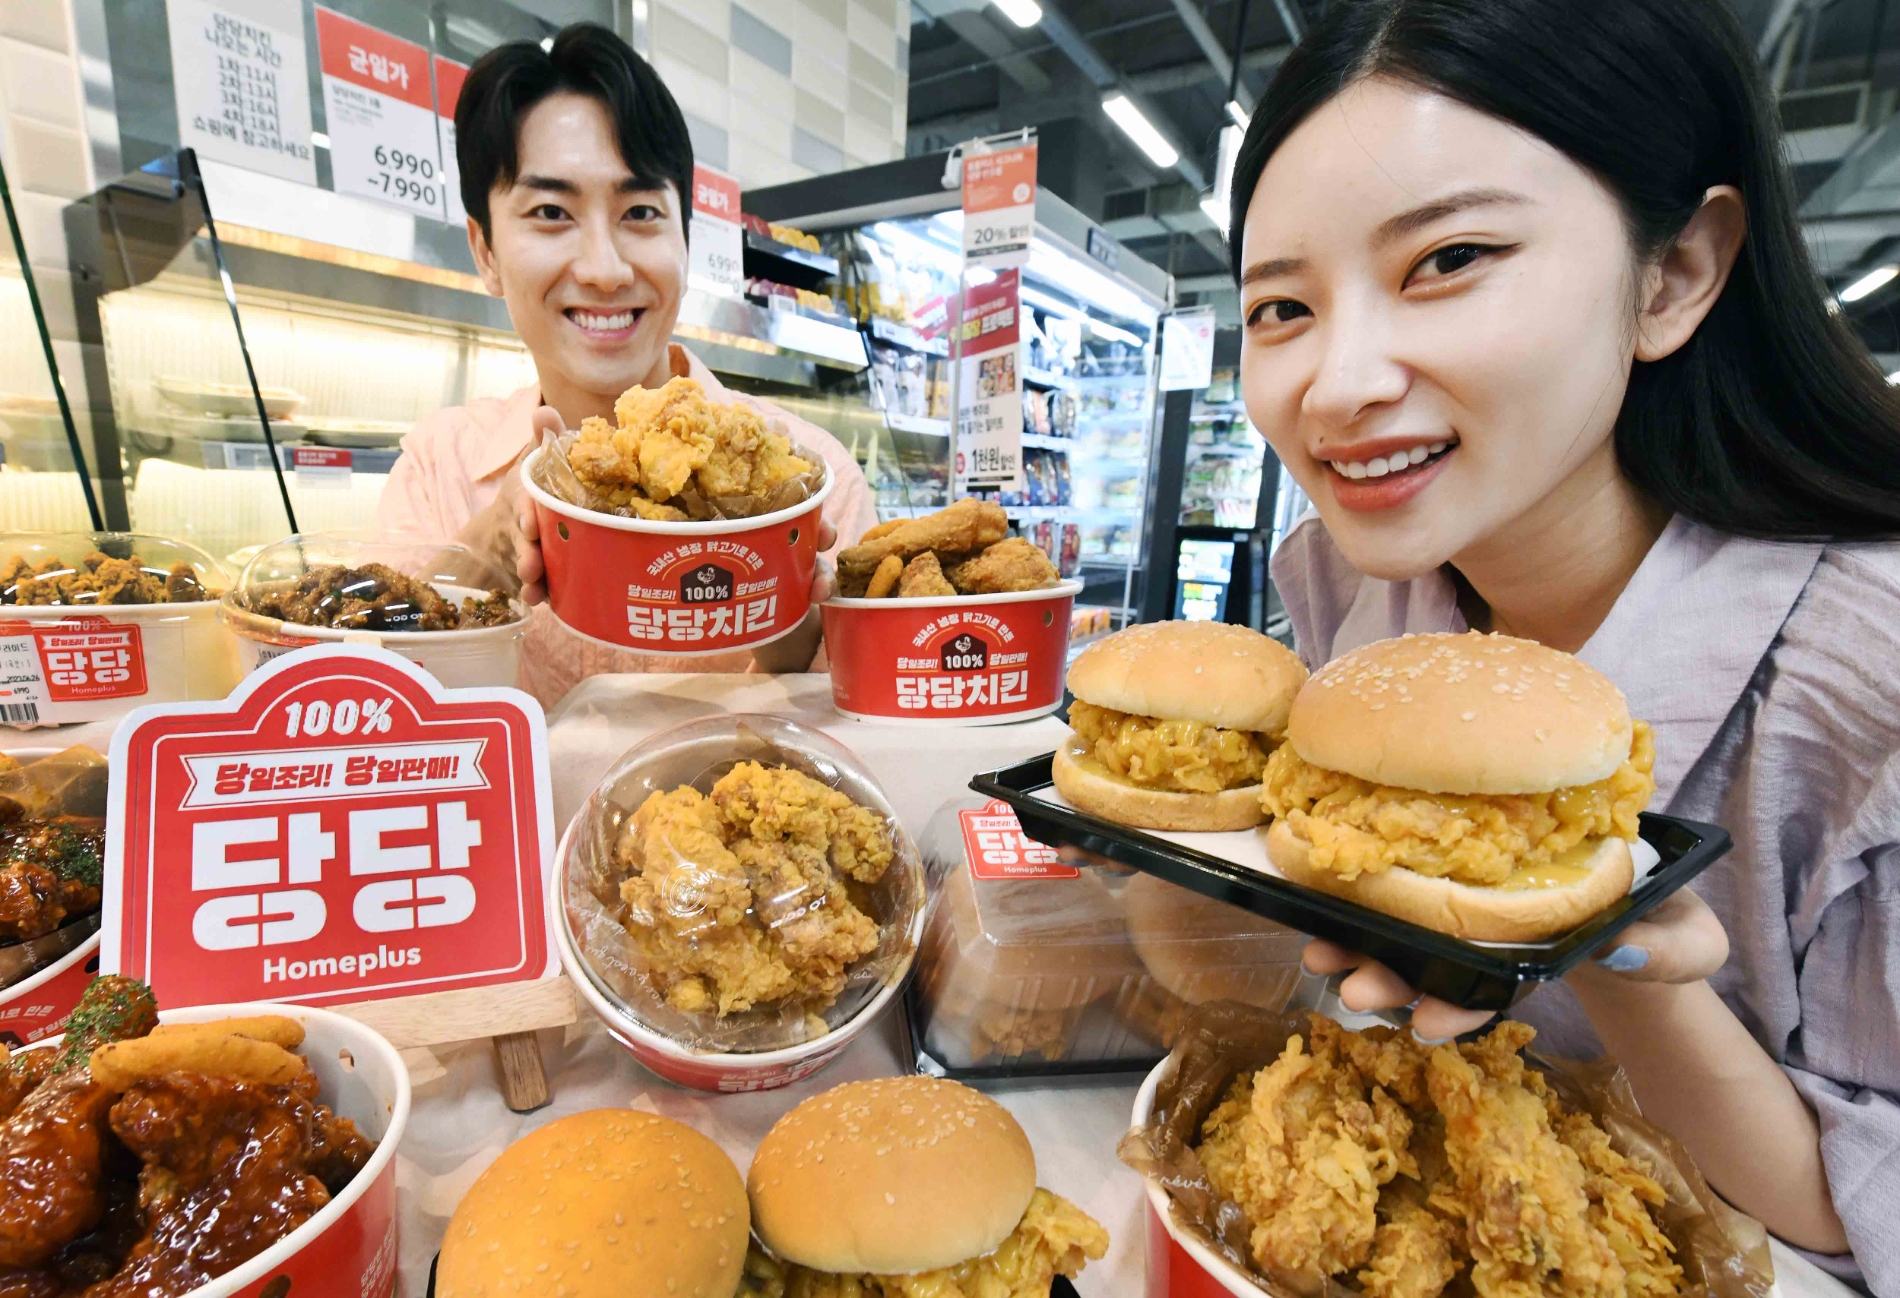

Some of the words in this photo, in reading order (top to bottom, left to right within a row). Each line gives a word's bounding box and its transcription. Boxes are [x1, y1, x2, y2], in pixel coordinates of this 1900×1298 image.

[255, 48, 281, 69] 시간
[348, 45, 409, 90] 균일가
[646, 551, 676, 576] 국내산
[676, 542, 702, 557] 냉장
[706, 541, 748, 556] 닭고기로
[746, 552, 765, 571] 만든
[628, 584, 676, 600] 당일조리!
[685, 585, 729, 601] 100%
[735, 576, 778, 596] 당일판매!
[626, 595, 778, 641] 당당치킨
[912, 622, 938, 647] 국내산
[936, 613, 959, 628] 냉장
[963, 612, 1000, 629] 닭고기로
[998, 624, 1015, 643] 만든
[0, 642, 29, 652] 라이드
[896, 657, 939, 669] 당일조리!
[945, 654, 983, 669] 100%
[989, 652, 1028, 666] 당일판매!
[47, 649, 131, 685] 당당
[71, 685, 116, 694] Homeplus
[896, 670, 1029, 709] 당당치킨
[285, 697, 393, 739] 100%
[213, 762, 332, 796] 당일조리!
[344, 755, 459, 786] 당일판매!
[191, 801, 483, 952] 당당
[1004, 866, 1047, 874] Homeplus
[263, 944, 422, 984] Homeplus
